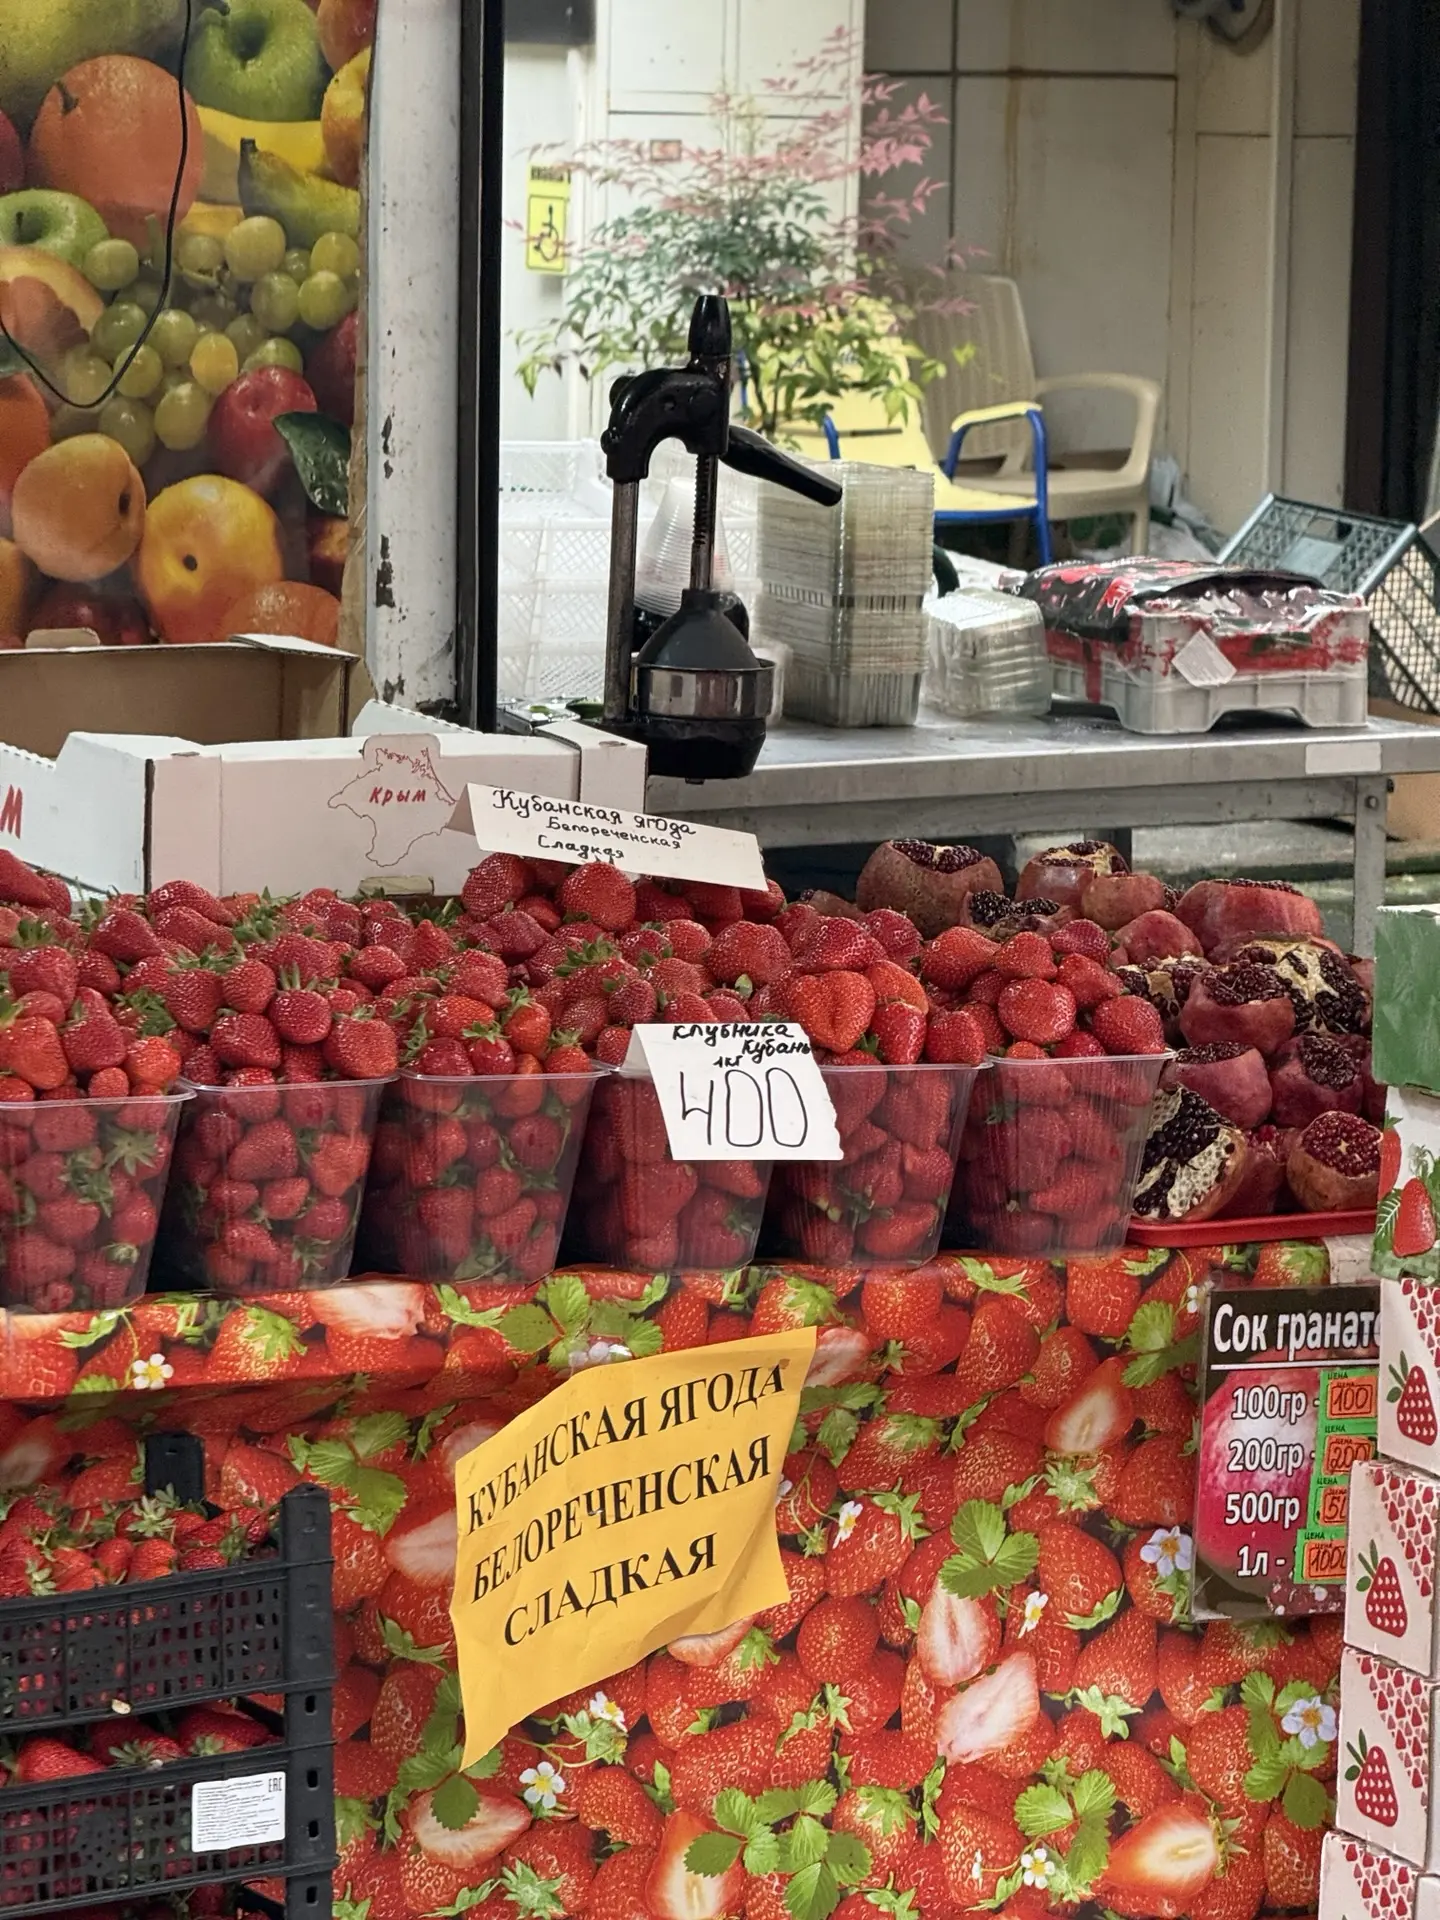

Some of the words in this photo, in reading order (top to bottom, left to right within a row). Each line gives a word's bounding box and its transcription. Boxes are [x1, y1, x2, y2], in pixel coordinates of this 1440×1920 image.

[492, 788, 623, 825] Кубанская
[537, 834, 625, 860] Сладкая
[546, 816, 682, 850] Белореченская
[680, 1067, 808, 1147] 400
[1213, 1303, 1269, 1353] Сок
[1231, 1385, 1307, 1423] 100гр
[1333, 1386, 1370, 1412] 100
[467, 1396, 649, 1536] КУБАНСКАЯ
[658, 1363, 786, 1432] ЯГОДА
[1228, 1438, 1304, 1476] 200гр
[471, 1434, 773, 1604] БЕЛОРЕЧЕНСКАЯ
[1225, 1492, 1300, 1529] 500гр
[1237, 1544, 1269, 1578] 1л
[503, 1531, 719, 1646] СЛАДКАЯ
